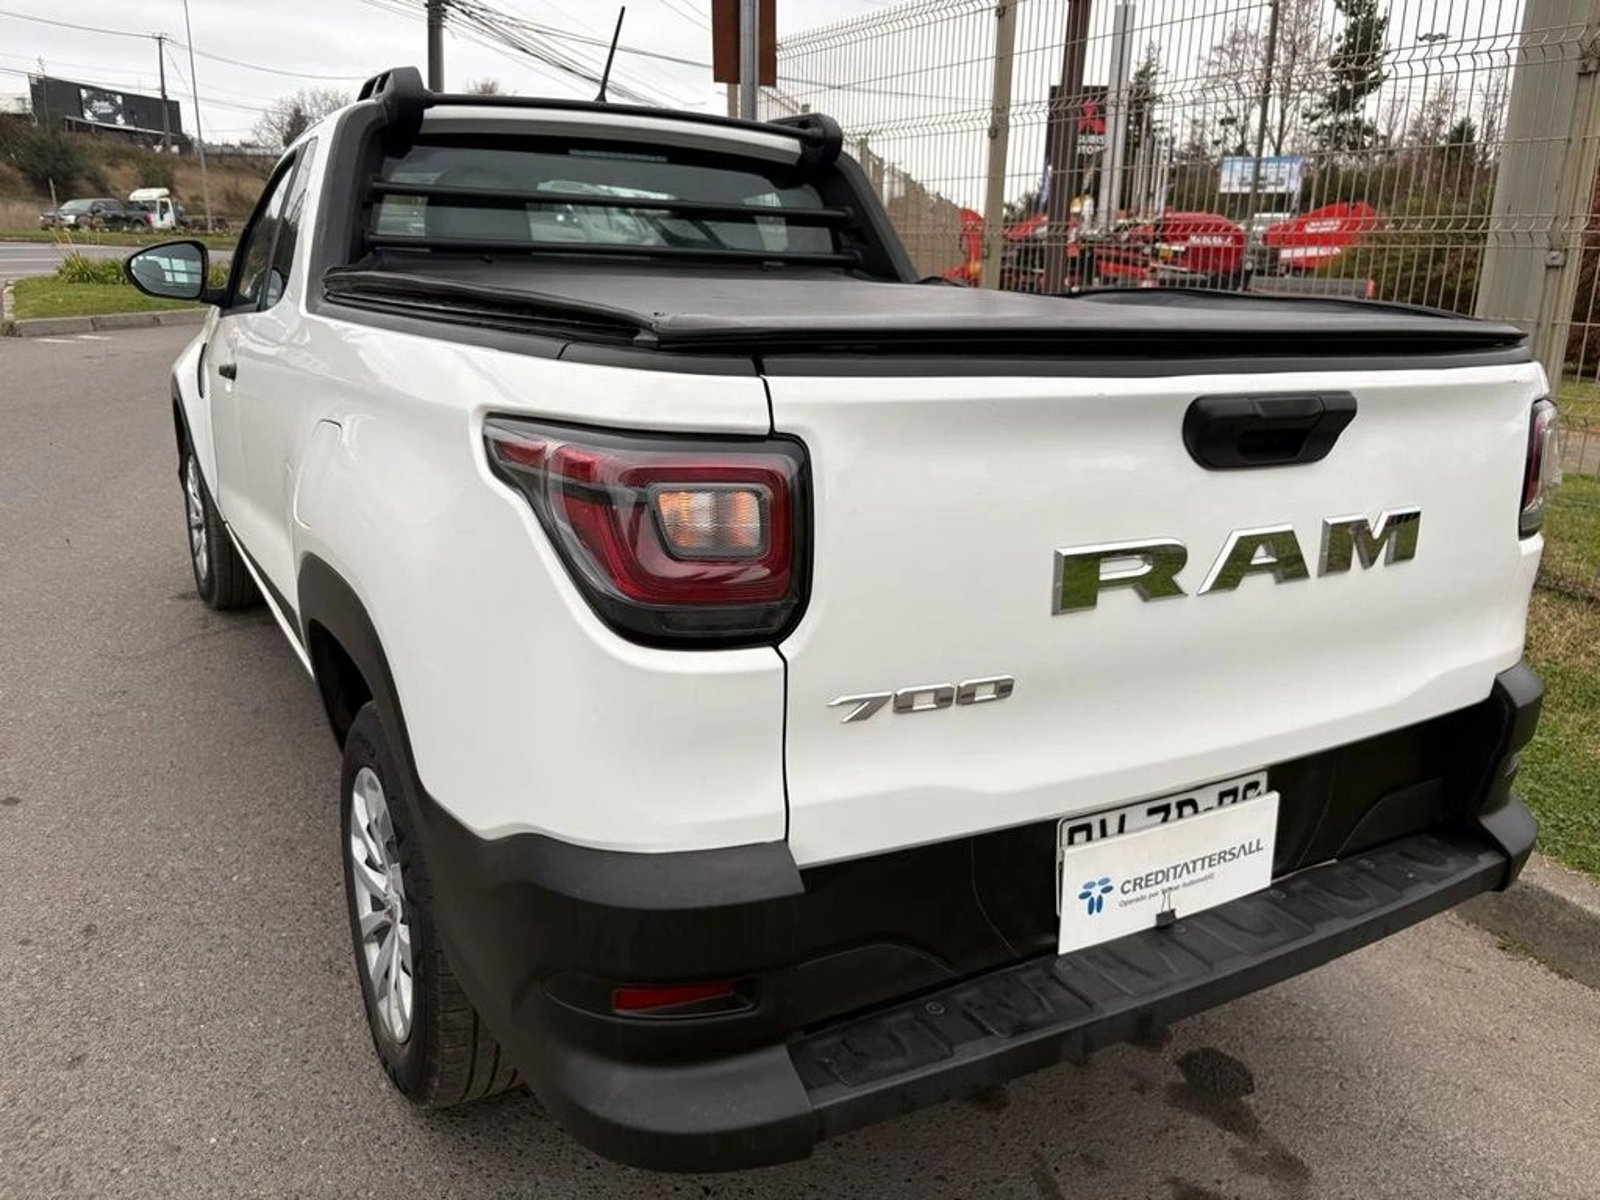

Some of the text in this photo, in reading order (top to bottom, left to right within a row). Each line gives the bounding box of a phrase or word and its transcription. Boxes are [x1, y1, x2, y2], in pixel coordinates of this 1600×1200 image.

[1051, 506, 1422, 616] RAM
[827, 674, 1015, 723] 700
[1120, 838, 1264, 895] CREDITATTERSALL
